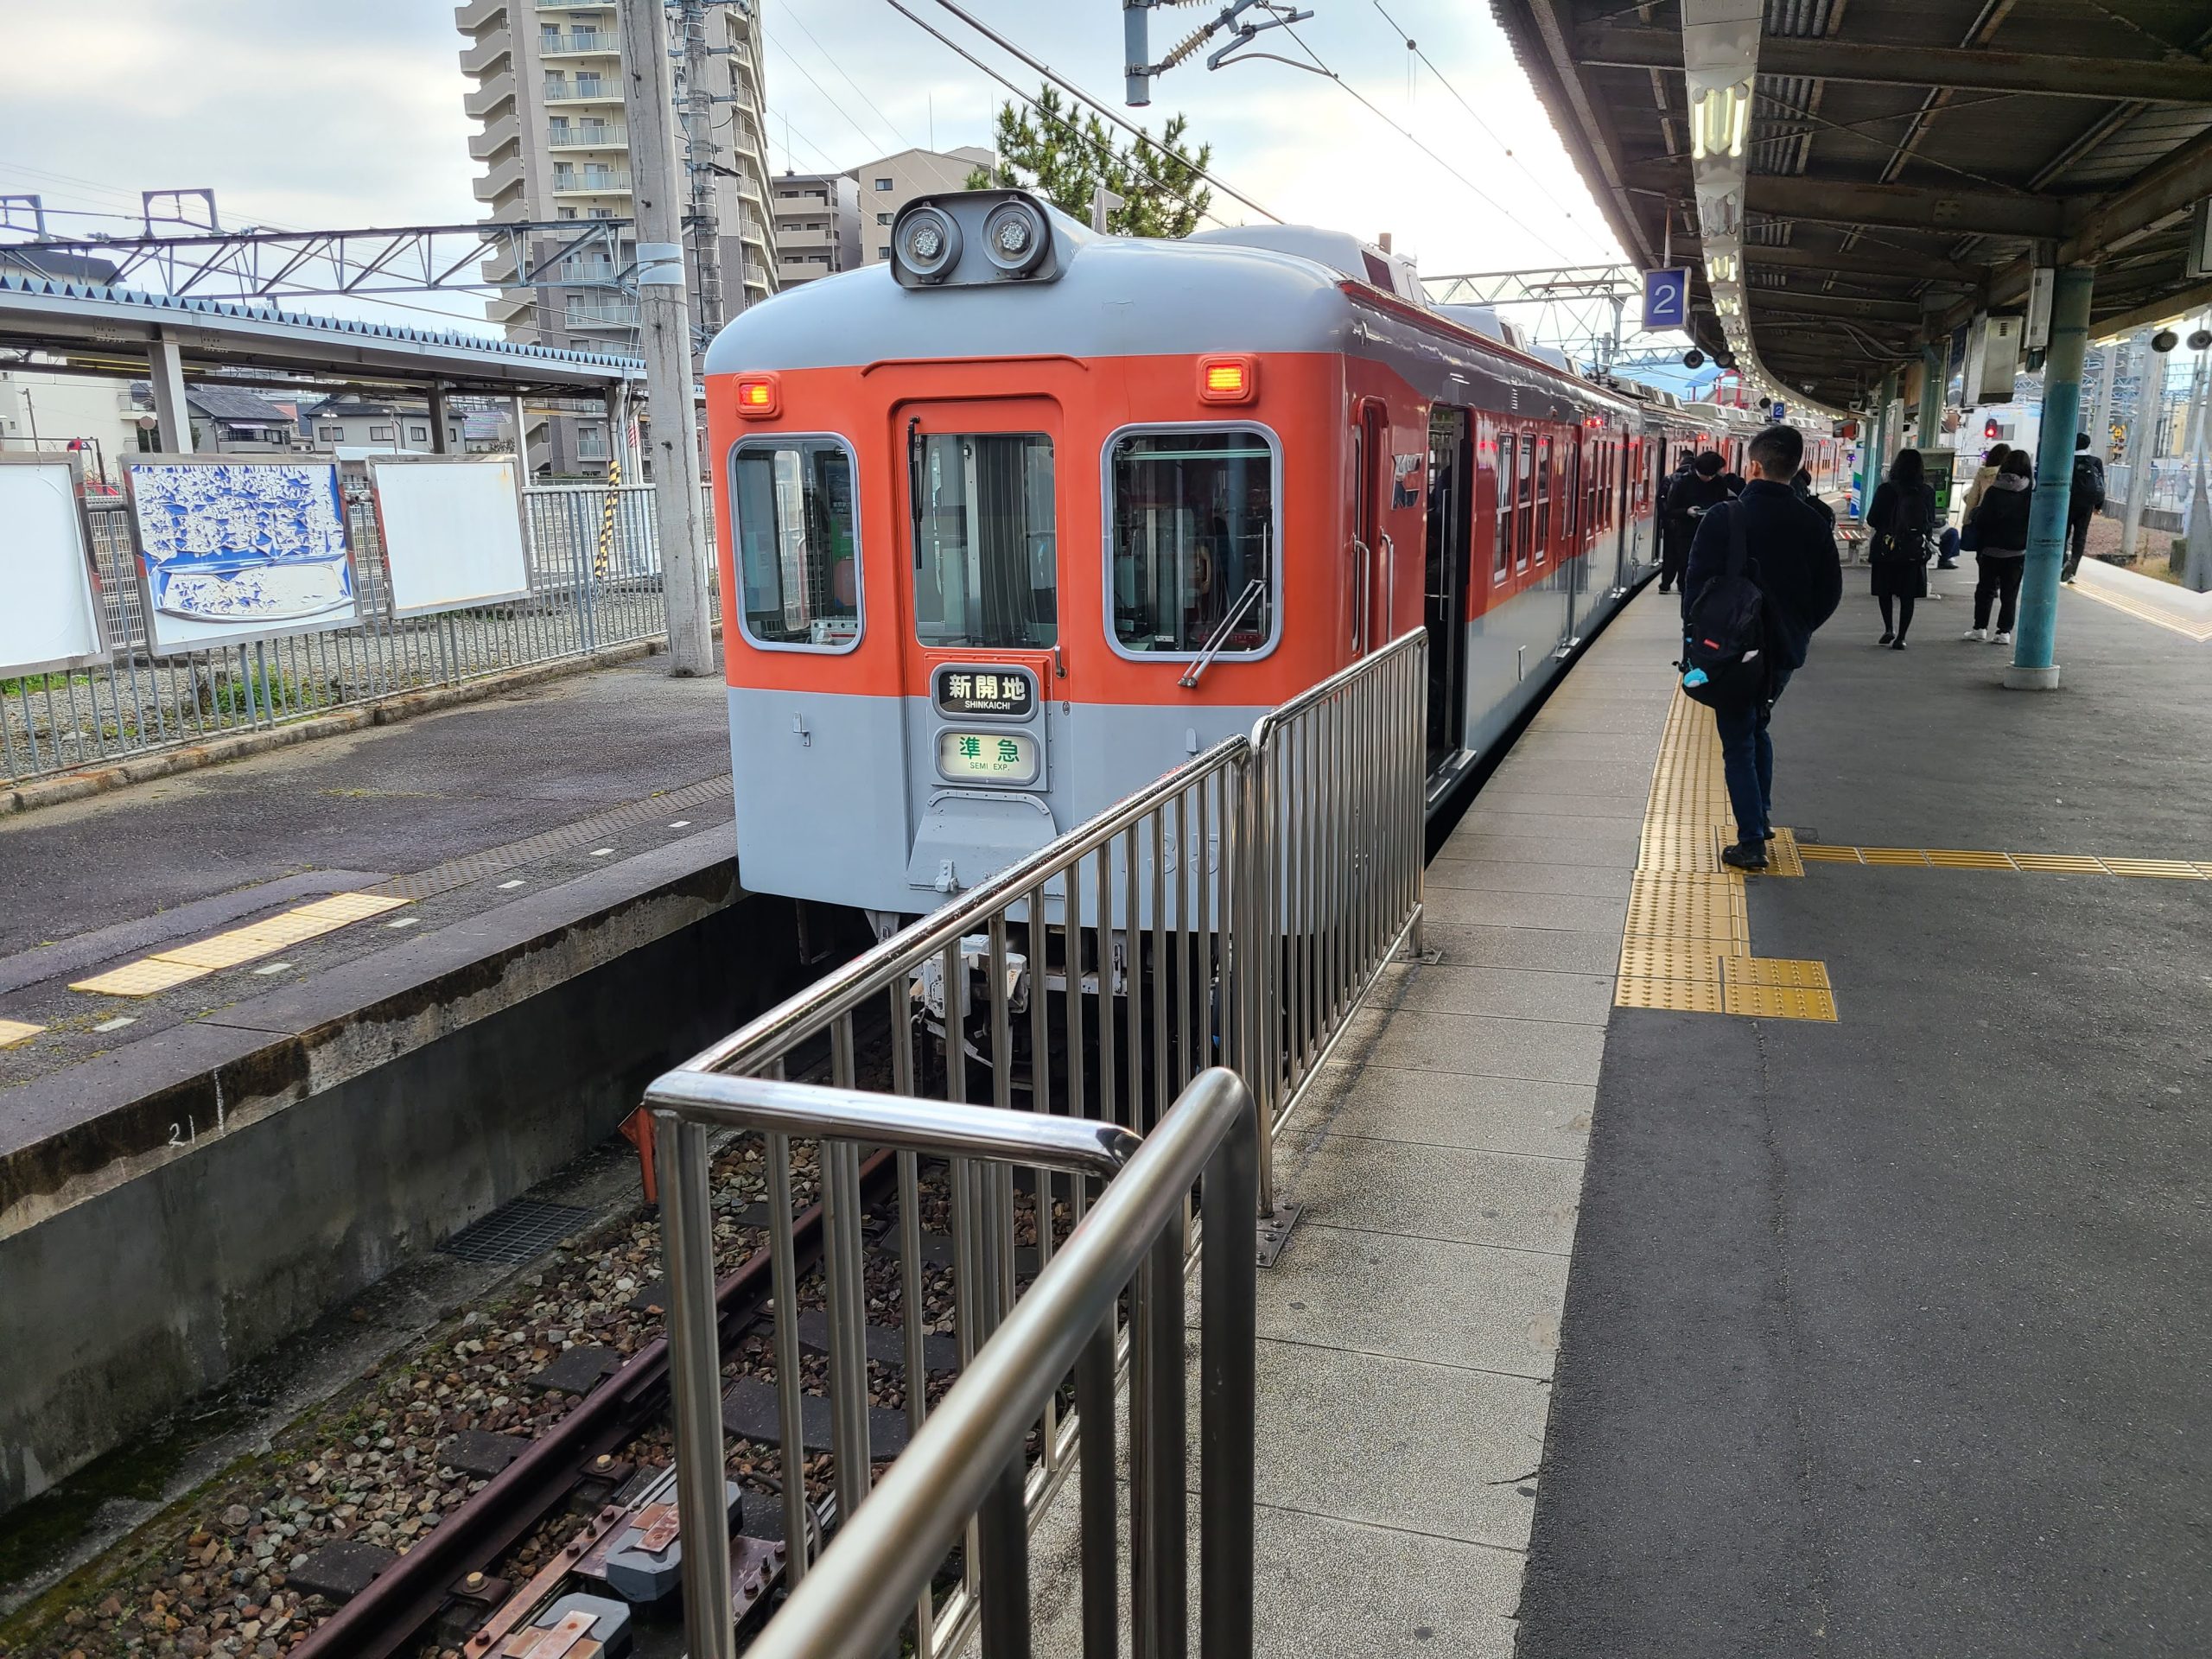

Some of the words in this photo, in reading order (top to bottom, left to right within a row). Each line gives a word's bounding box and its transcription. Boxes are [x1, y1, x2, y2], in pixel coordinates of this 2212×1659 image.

[1653, 284, 1676, 315] 2
[1775, 406, 1783, 416] 2
[949, 674, 1027, 701] 新開地
[964, 700, 1011, 710] SHINKAICHI
[958, 736, 1020, 763] 準急
[969, 761, 988, 771] SEMI
[993, 763, 1010, 772] EXP.
[168, 1114, 195, 1148] 21
